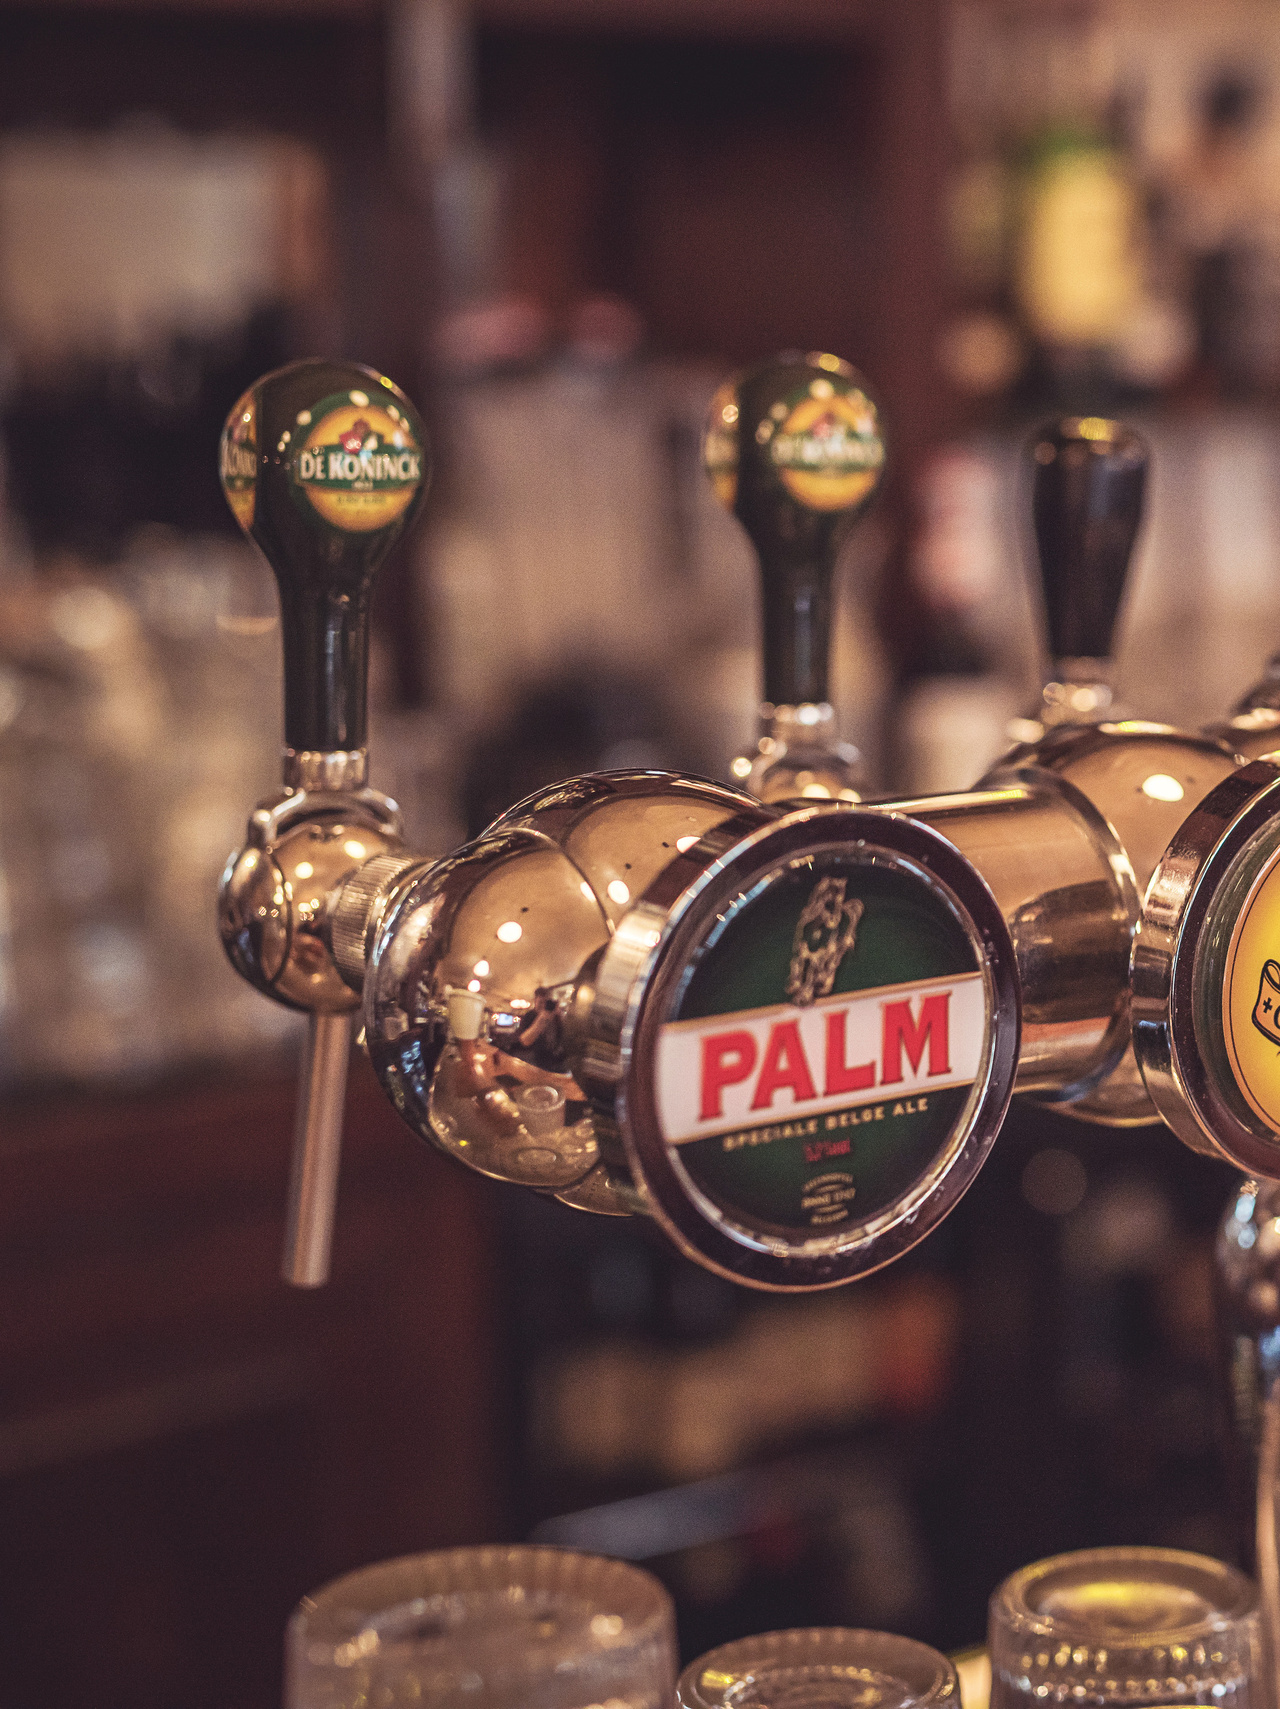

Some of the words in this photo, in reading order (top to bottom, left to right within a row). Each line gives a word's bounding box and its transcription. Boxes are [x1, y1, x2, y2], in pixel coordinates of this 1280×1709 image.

[300, 452, 326, 480] DE
[328, 452, 421, 480] KONINCK
[698, 990, 952, 1122] PALM
[722, 1119, 819, 1152] SPECIALE
[825, 1106, 885, 1131] BELGE
[892, 1097, 929, 1116] ALE
